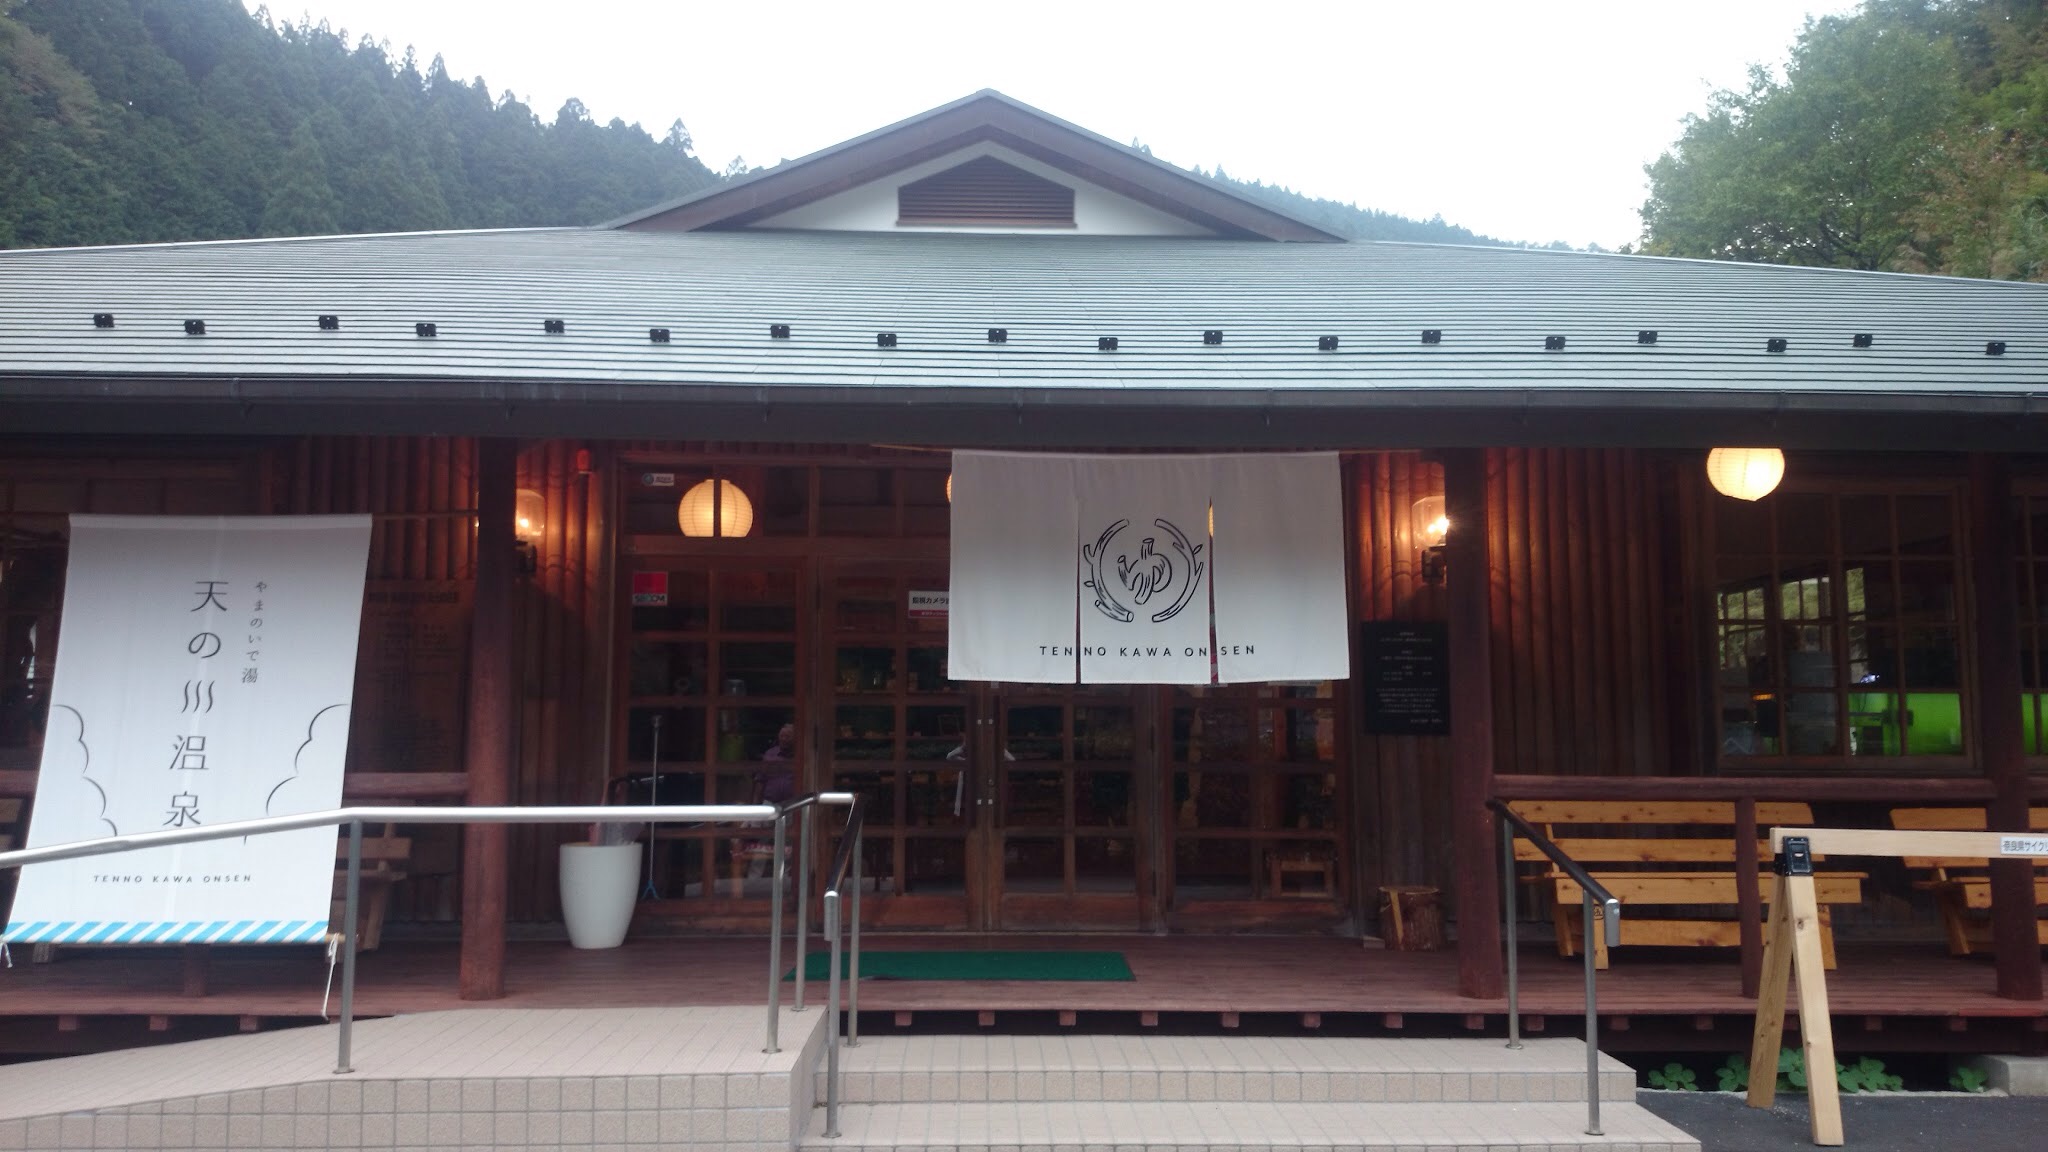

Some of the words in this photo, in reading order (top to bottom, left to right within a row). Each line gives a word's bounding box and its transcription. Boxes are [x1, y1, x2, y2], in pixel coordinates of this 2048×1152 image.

[241, 580, 268, 684] やまのいで湯
[1120, 647, 1172, 657] KAWA
[93, 875, 143, 884] TENNO
[152, 875, 193, 884] KAWA
[203, 874, 252, 884] ONSEN
